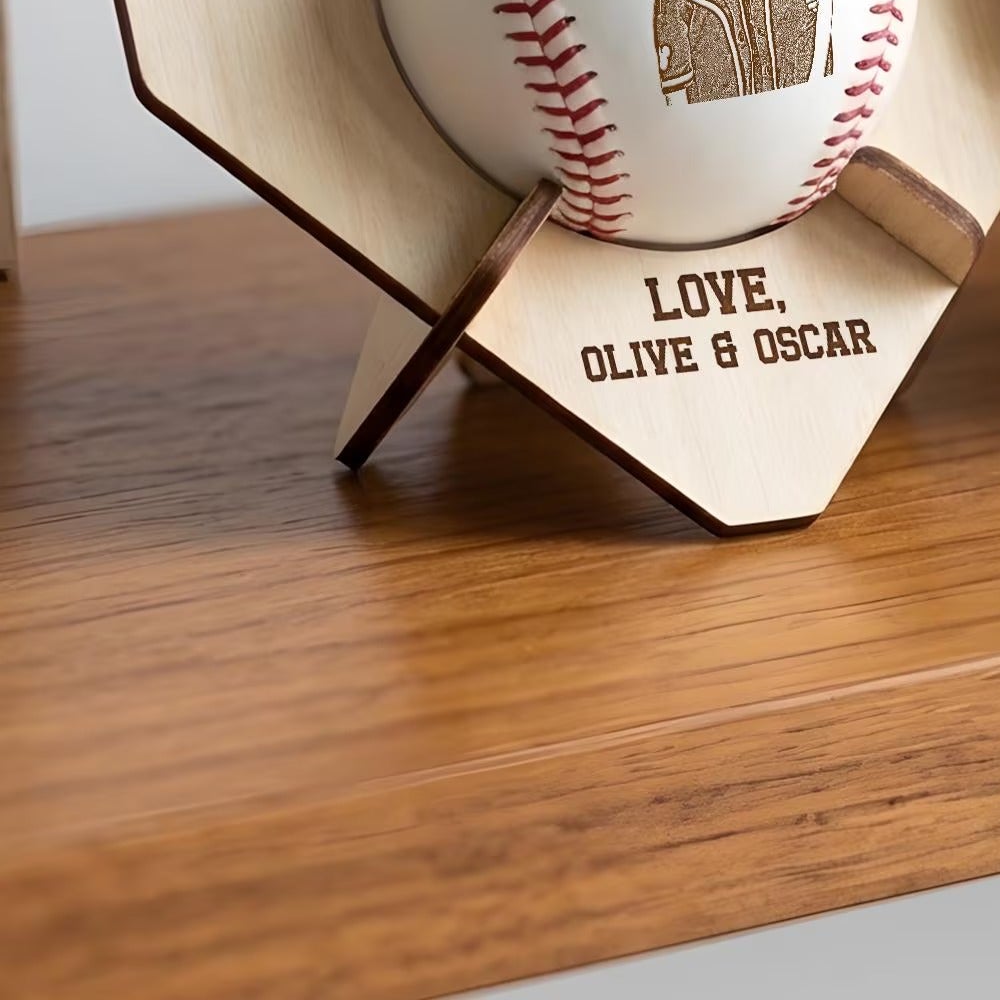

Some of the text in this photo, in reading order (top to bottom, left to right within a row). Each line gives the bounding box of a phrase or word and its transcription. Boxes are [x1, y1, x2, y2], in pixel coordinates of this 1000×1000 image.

[644, 267, 786, 322] LOVE,
[581, 318, 877, 382] OLIVE & OSCAR
